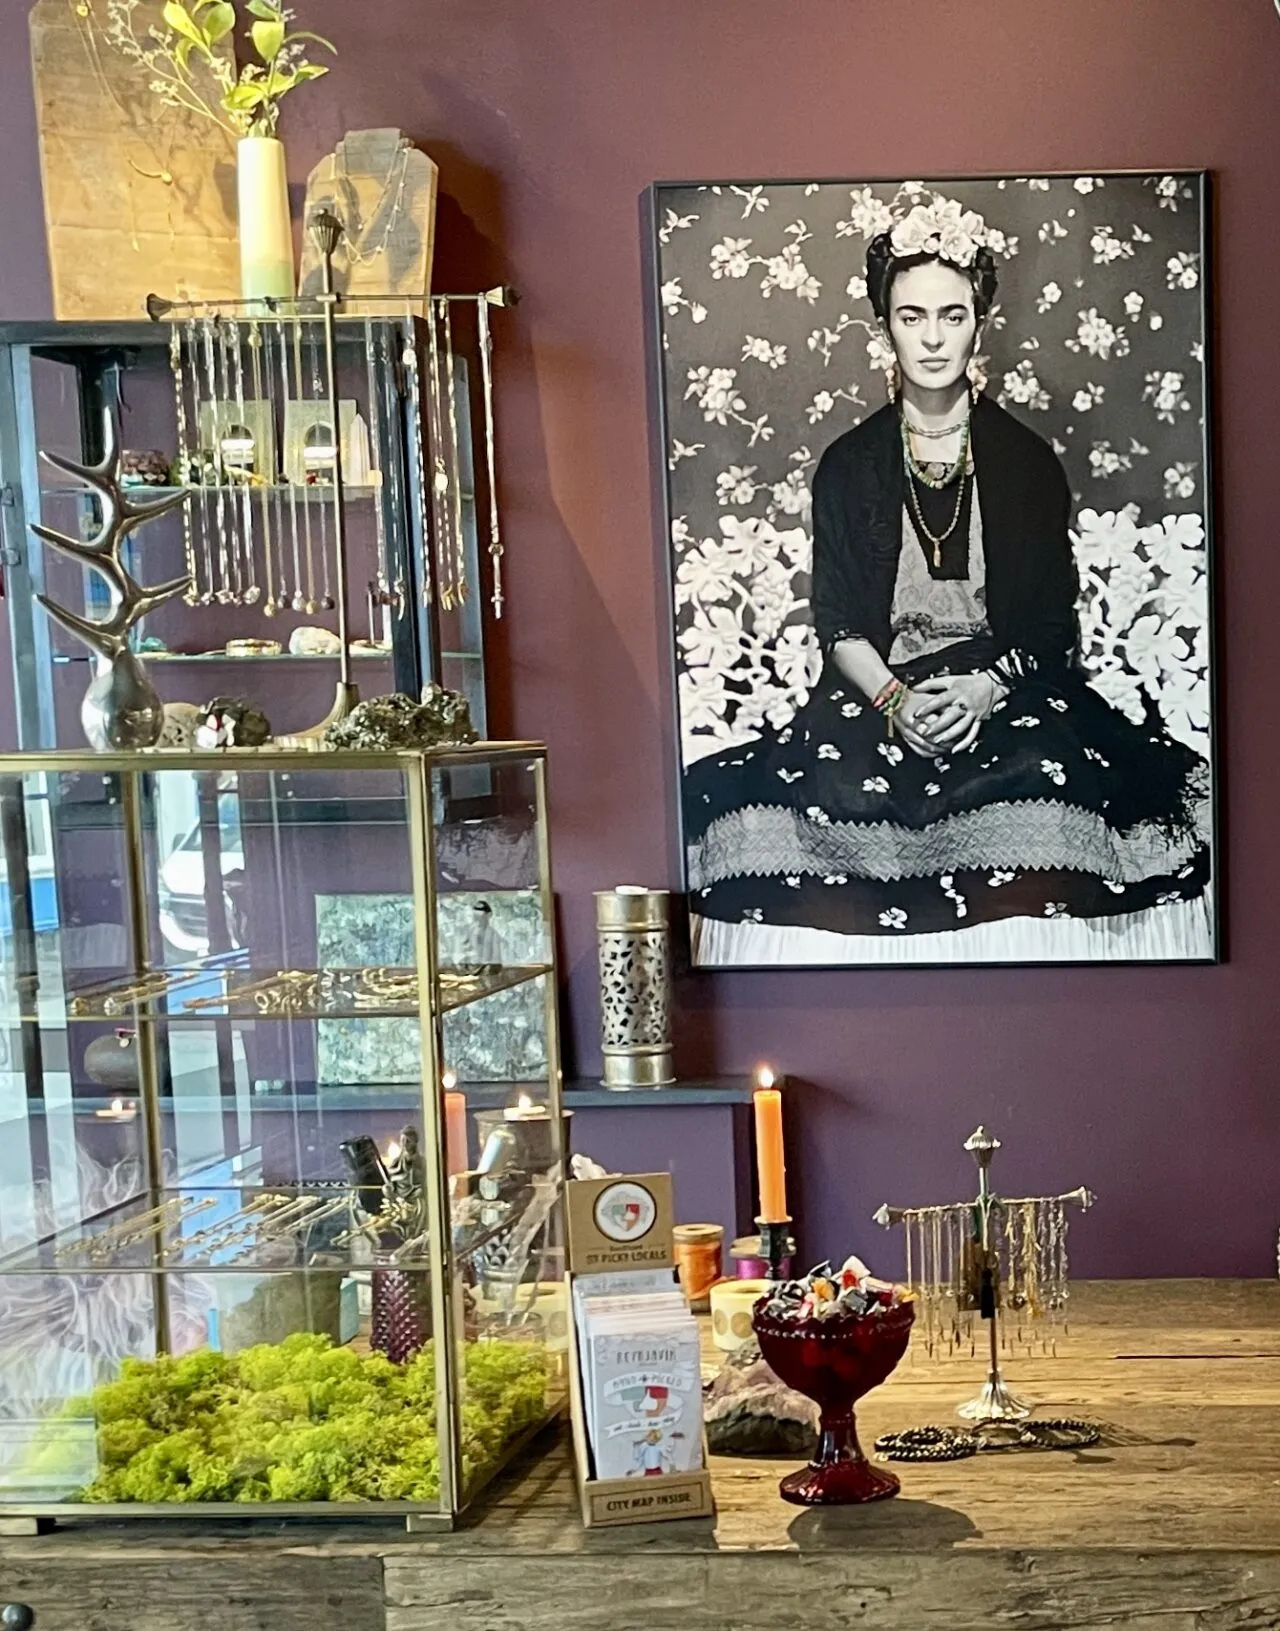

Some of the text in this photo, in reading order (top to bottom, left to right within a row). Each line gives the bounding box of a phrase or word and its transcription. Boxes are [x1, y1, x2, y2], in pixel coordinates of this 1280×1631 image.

[631, 1249, 667, 1261] LOCALS
[606, 1492, 690, 1511] CITY MAP INSIDE
